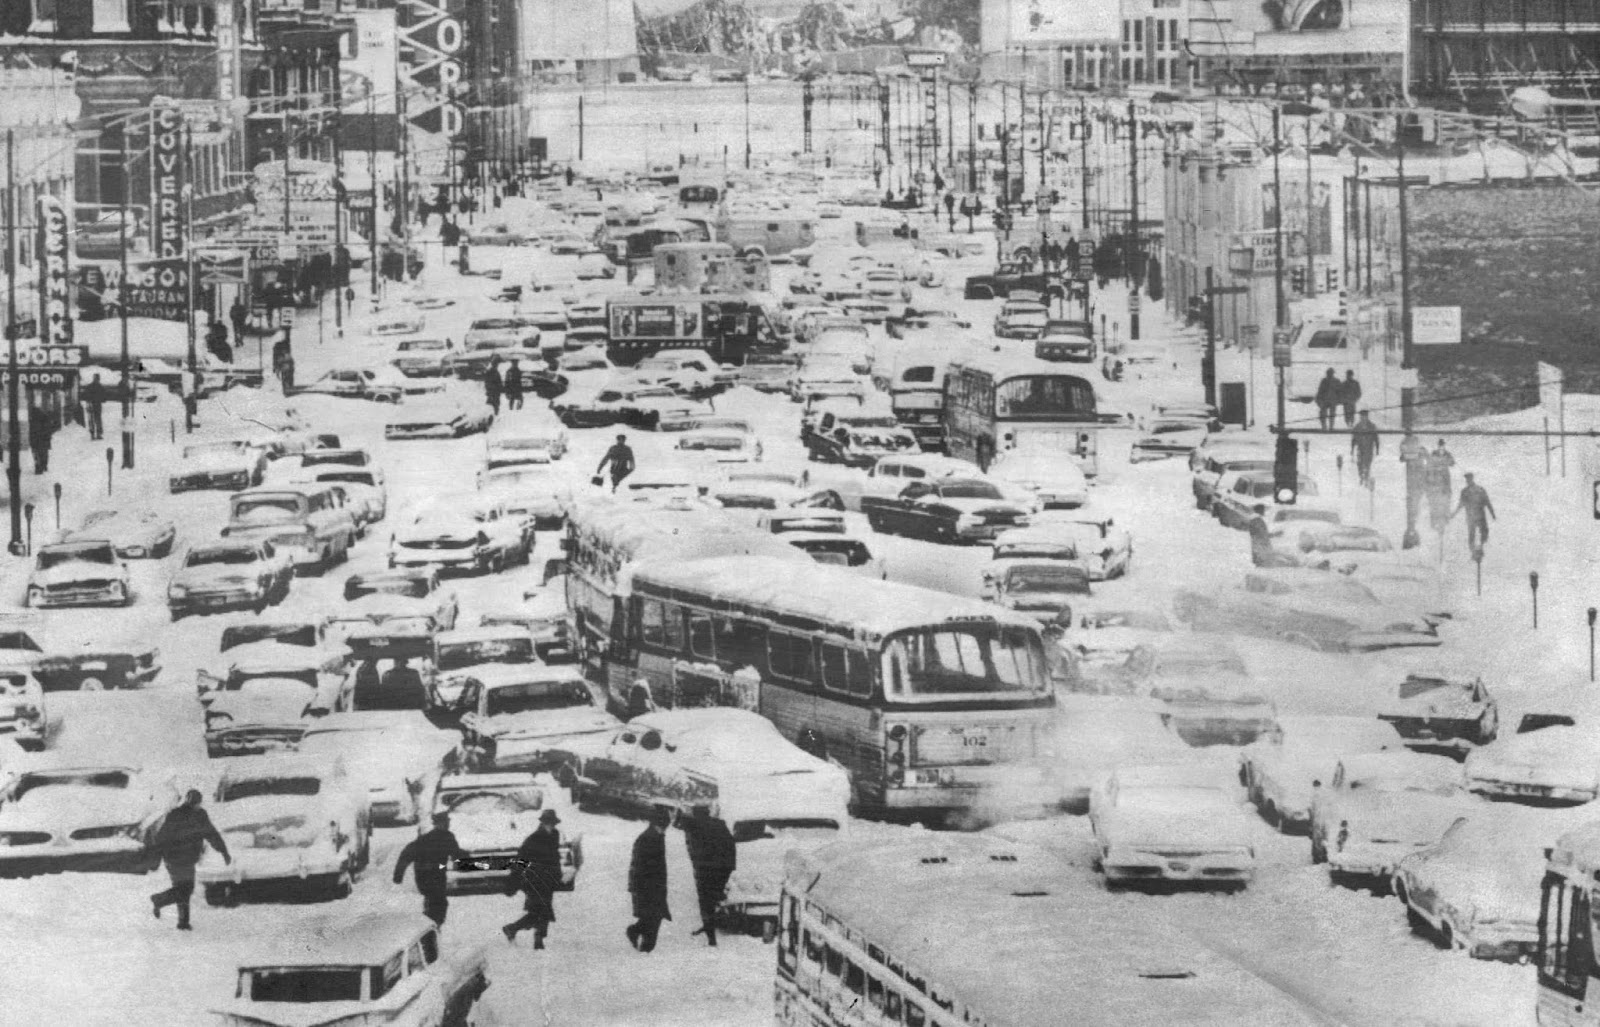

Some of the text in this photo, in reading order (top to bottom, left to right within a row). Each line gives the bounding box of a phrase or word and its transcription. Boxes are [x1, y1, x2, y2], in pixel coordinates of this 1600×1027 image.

[438, 0, 461, 137] ORD
[158, 109, 177, 259] COVERED
[46, 210, 66, 341] CERMAK
[963, 736, 987, 747] 102
